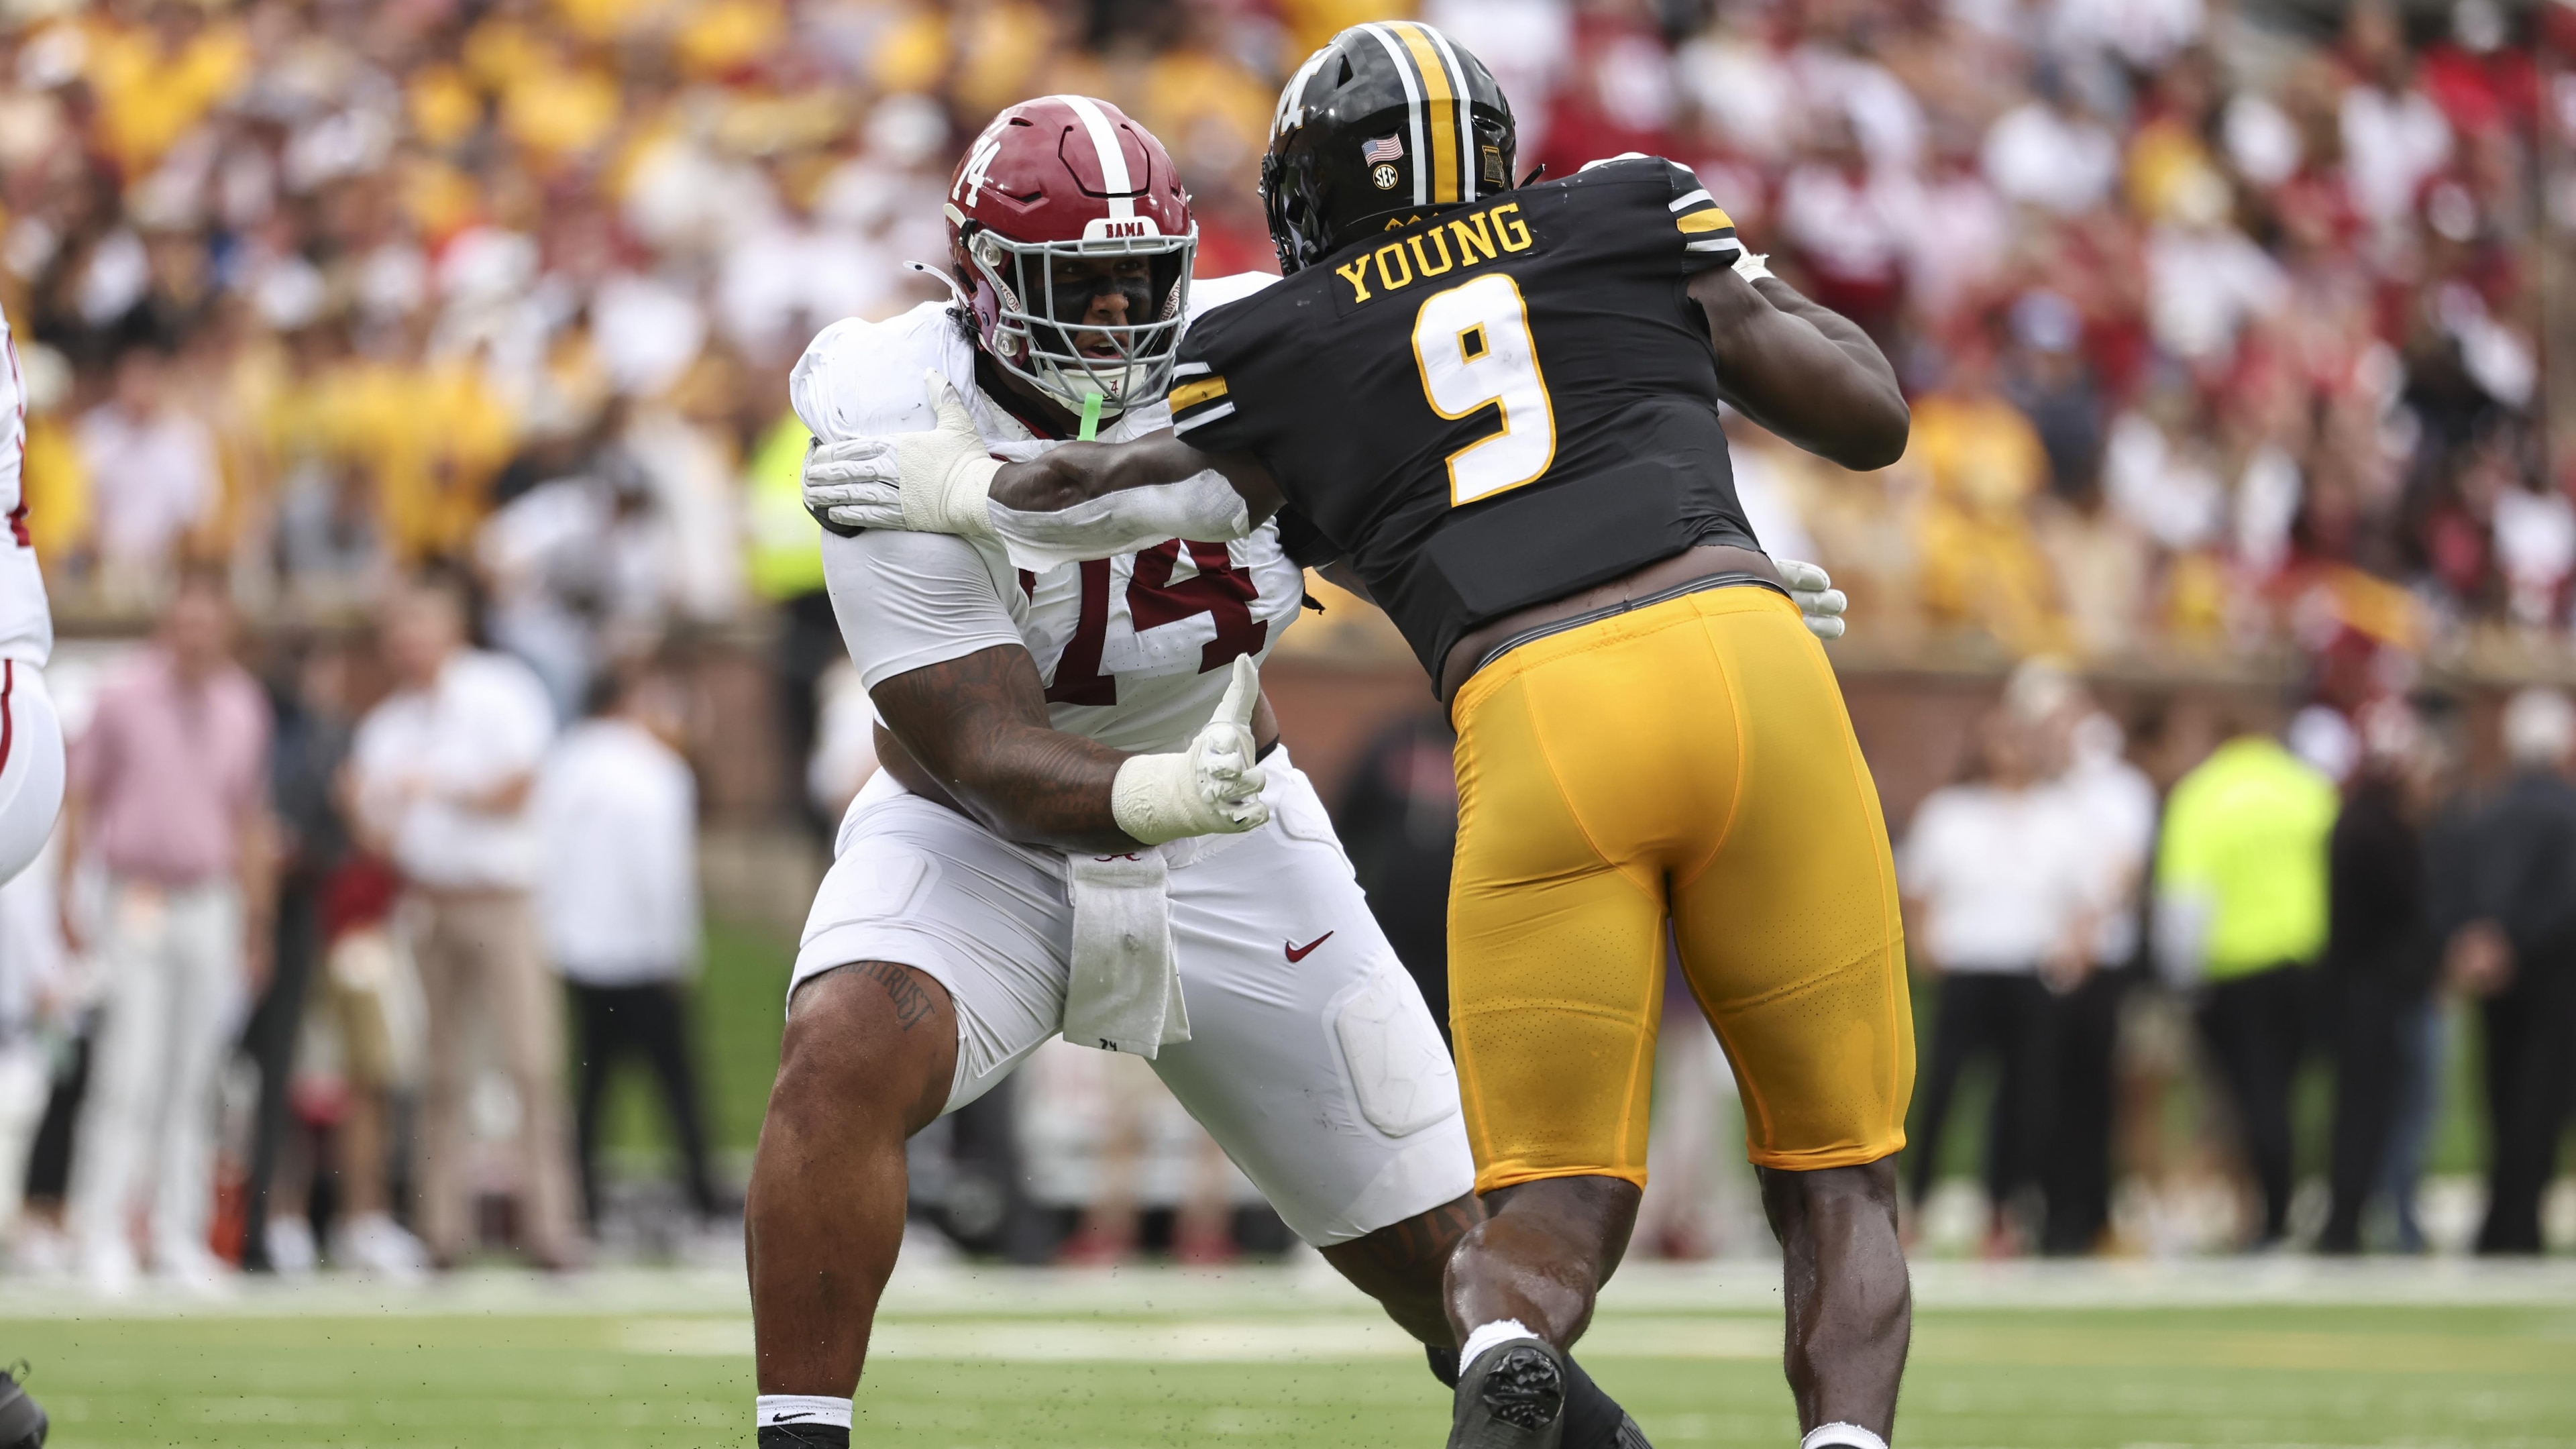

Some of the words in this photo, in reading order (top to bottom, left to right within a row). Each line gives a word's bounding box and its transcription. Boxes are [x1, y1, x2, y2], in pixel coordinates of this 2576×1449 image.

[952, 135, 1001, 208] 74
[1375, 166, 1395, 188] SEC
[1106, 222, 1145, 238] BAMA
[1335, 203, 1533, 304] YOUNG
[1411, 273, 1556, 508] 9
[1019, 538, 1268, 706] 74
[1099, 1038, 1117, 1051] 74
